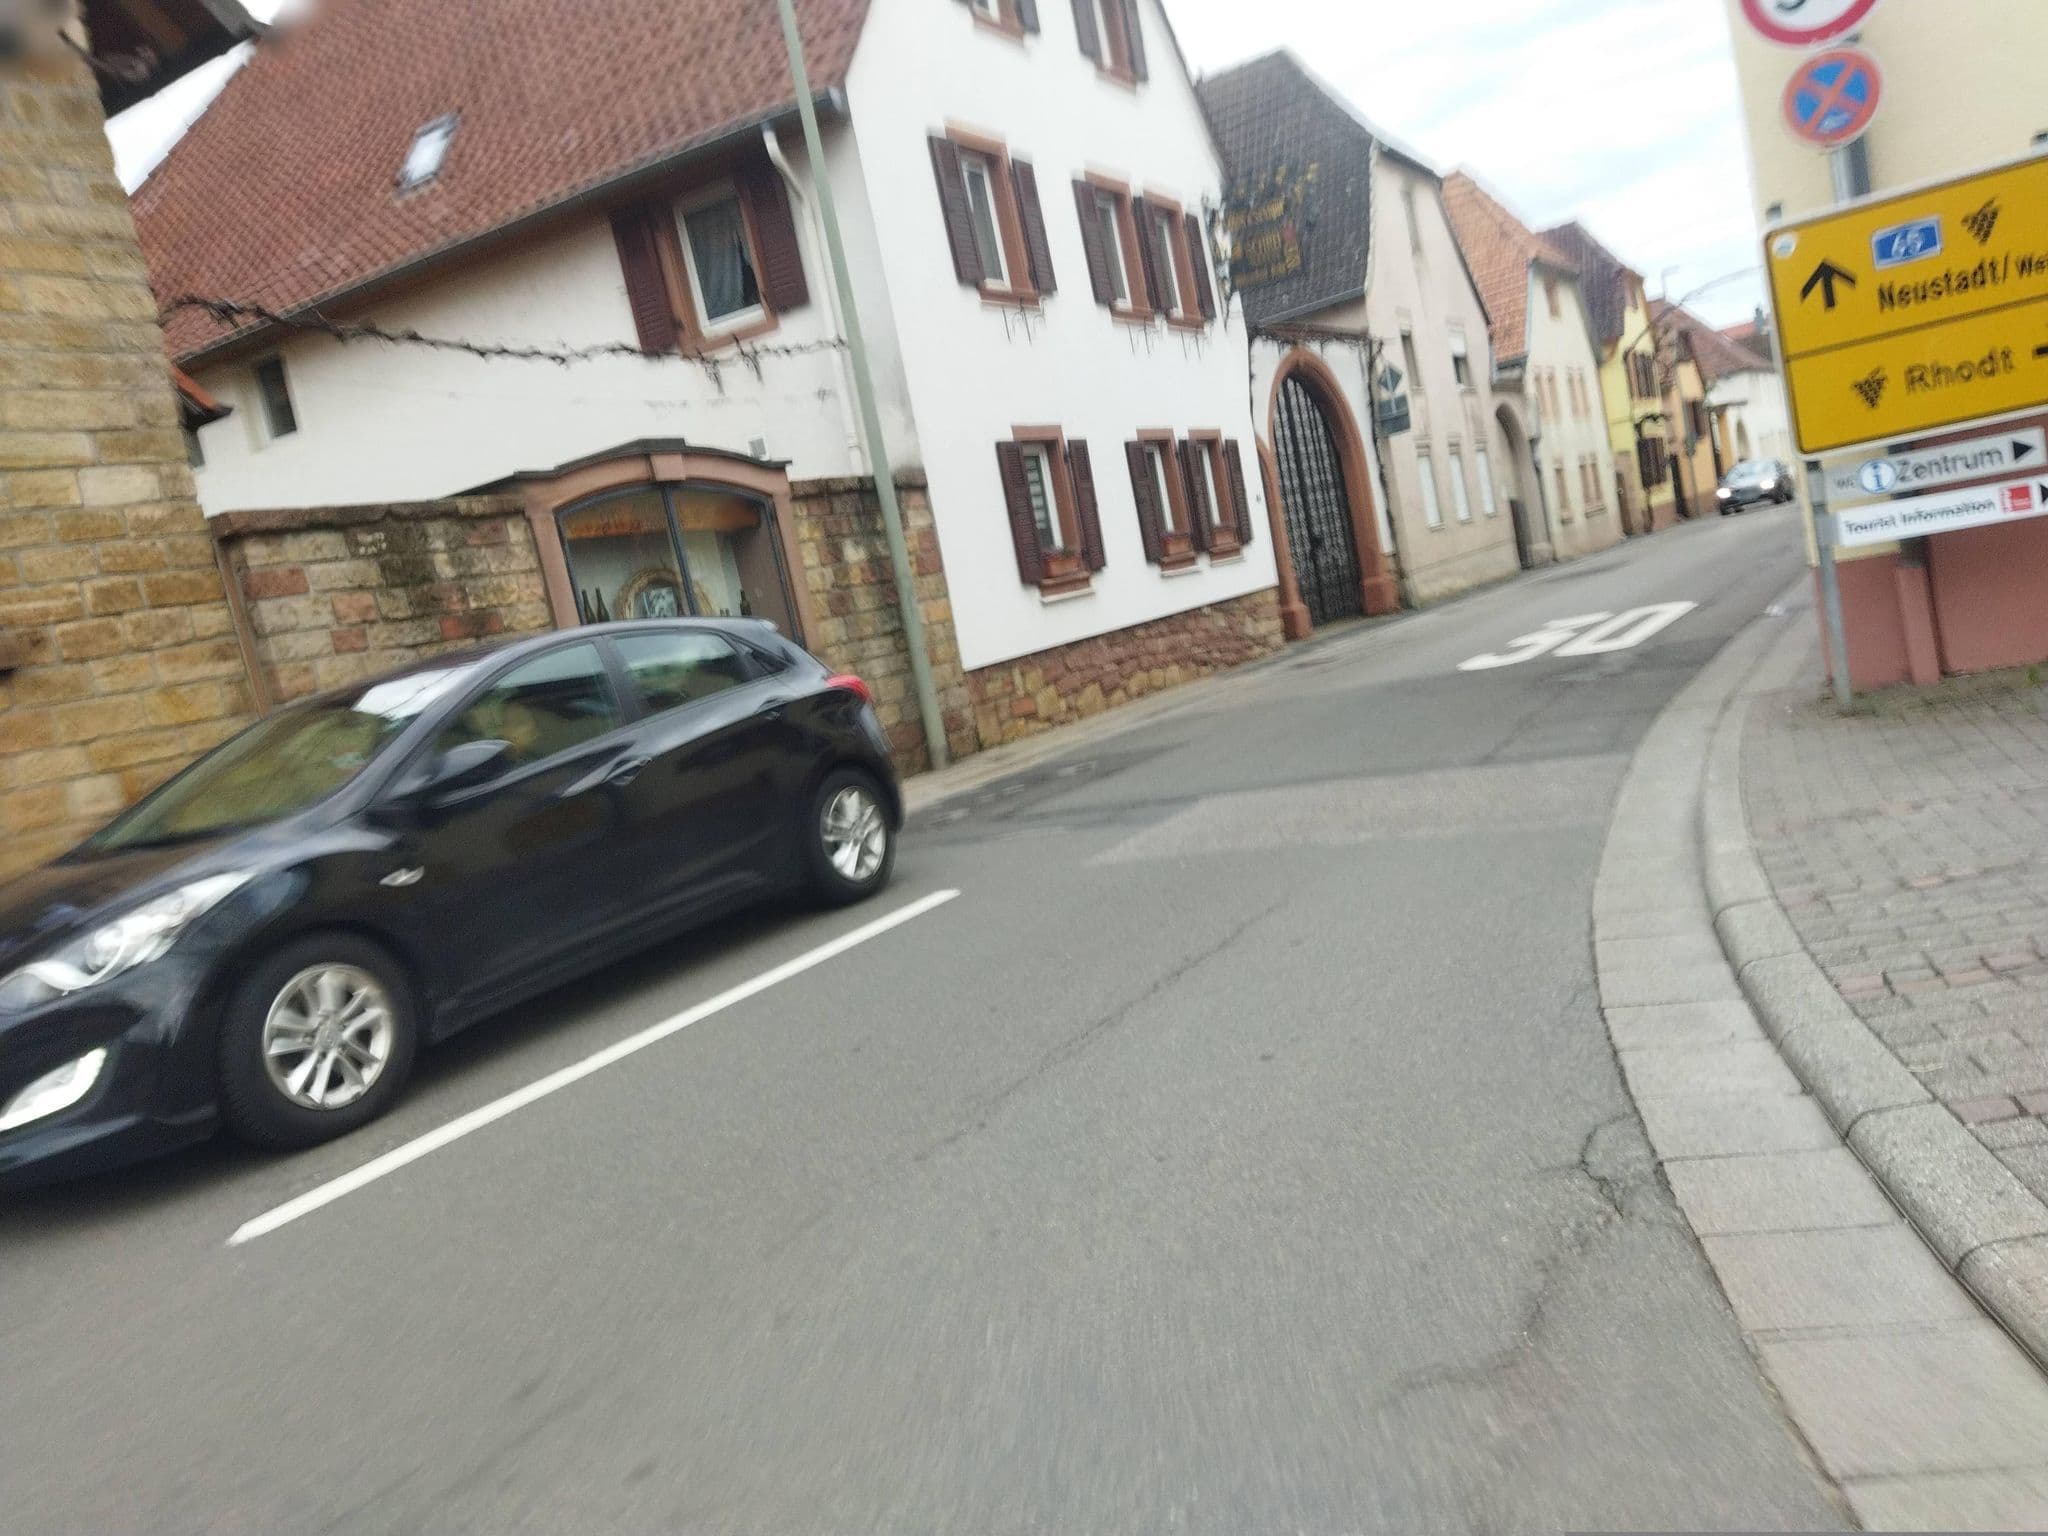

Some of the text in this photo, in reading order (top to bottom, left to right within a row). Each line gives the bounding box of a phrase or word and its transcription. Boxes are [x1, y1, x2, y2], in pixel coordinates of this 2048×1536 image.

[1905, 345, 2014, 394] Rhodt
[1896, 448, 2004, 482] Zentrum
[1845, 514, 1897, 535] Tourist
[1902, 497, 1996, 524] Information
[1456, 600, 1700, 671] 30
